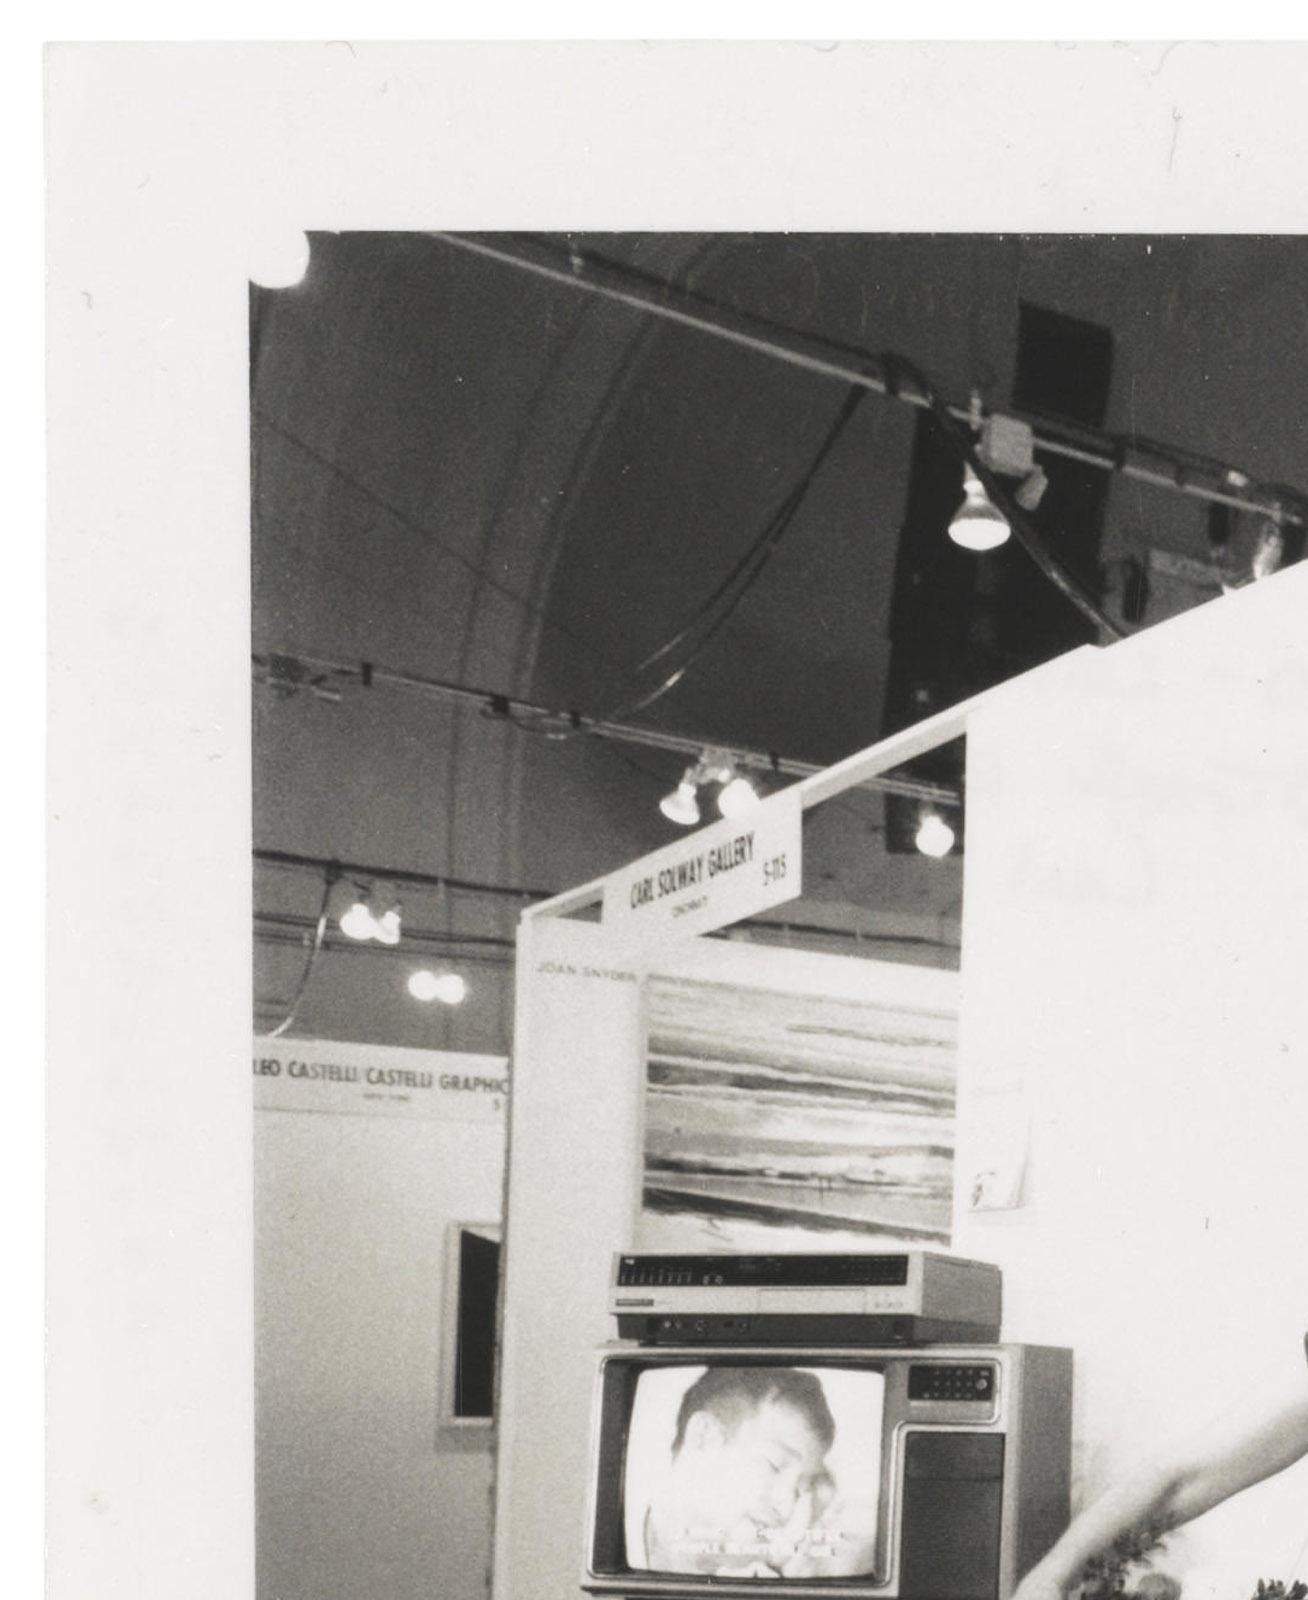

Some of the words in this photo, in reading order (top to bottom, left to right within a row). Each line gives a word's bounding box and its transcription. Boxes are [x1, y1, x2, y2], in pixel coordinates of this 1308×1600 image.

[630, 876, 655, 910] CARL
[657, 854, 705, 899] SOLWAY
[708, 831, 756, 879] GALLERY
[365, 1068, 432, 1089] CASTELLI
